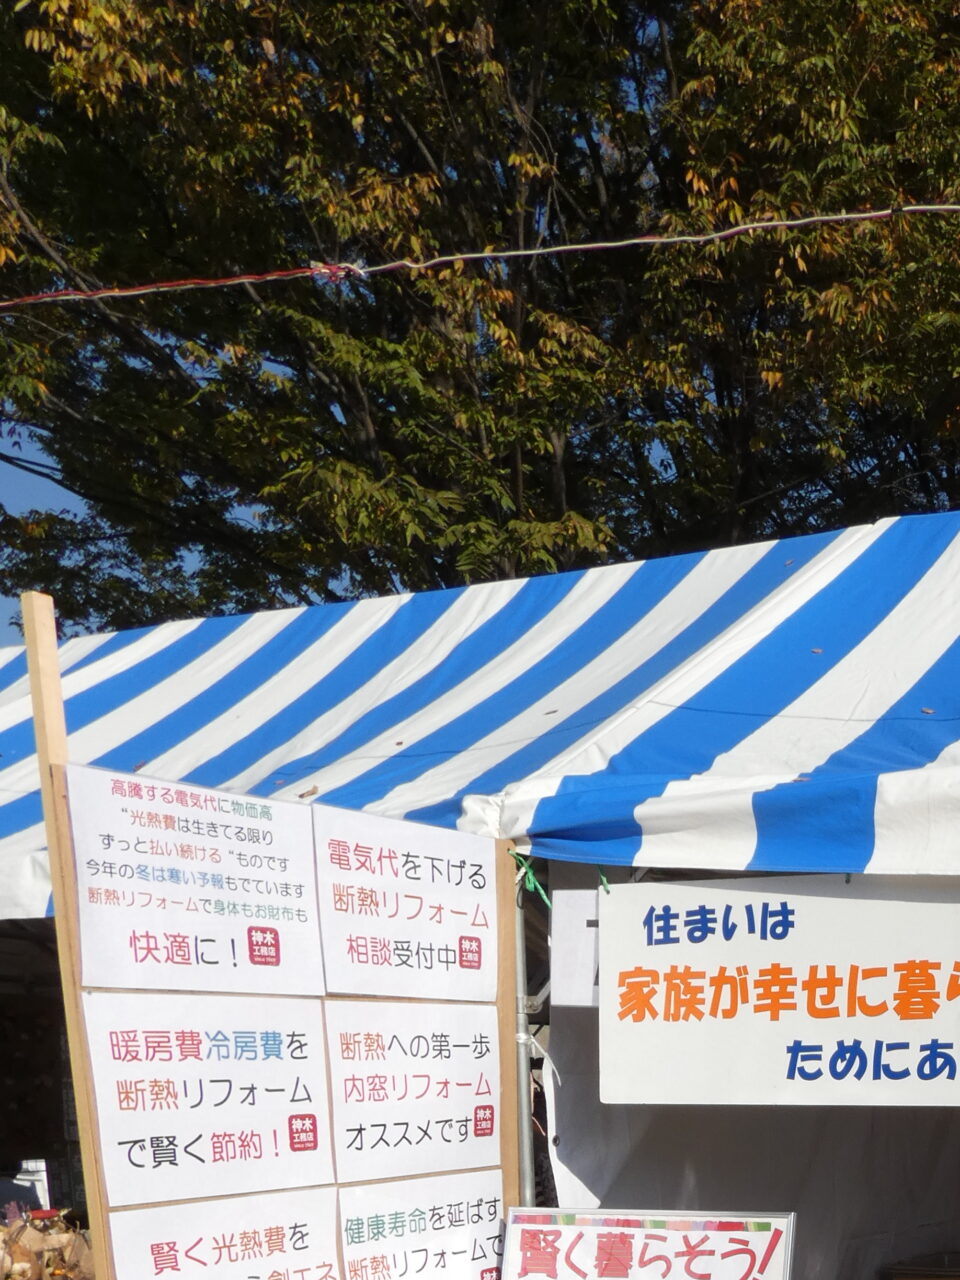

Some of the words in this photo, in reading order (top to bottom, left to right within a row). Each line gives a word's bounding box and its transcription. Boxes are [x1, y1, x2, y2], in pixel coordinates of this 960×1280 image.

[111, 778, 273, 821] 高騰する電気代に物価高
[86, 858, 305, 899] 今年の冬は寒い予報もでています
[328, 839, 486, 890] 電気代を下げる
[88, 886, 308, 923] 断熱リフォームで身体もお財布も
[333, 883, 489, 929] 断熱リフォーム
[643, 902, 796, 946] 住まいは
[346, 934, 457, 971] 相談受付中
[109, 1029, 309, 1063] 暖房費冷房費を
[339, 1032, 490, 1061] 断熱への第一歩
[116, 1076, 312, 1112] 断熱リフォーム
[344, 1072, 492, 1103] 内窓リフォーム
[346, 1116, 473, 1150] オススメです
[344, 1197, 501, 1246] 健康寿命を延ばす
[150, 1222, 309, 1276] 賢く光熱費を
